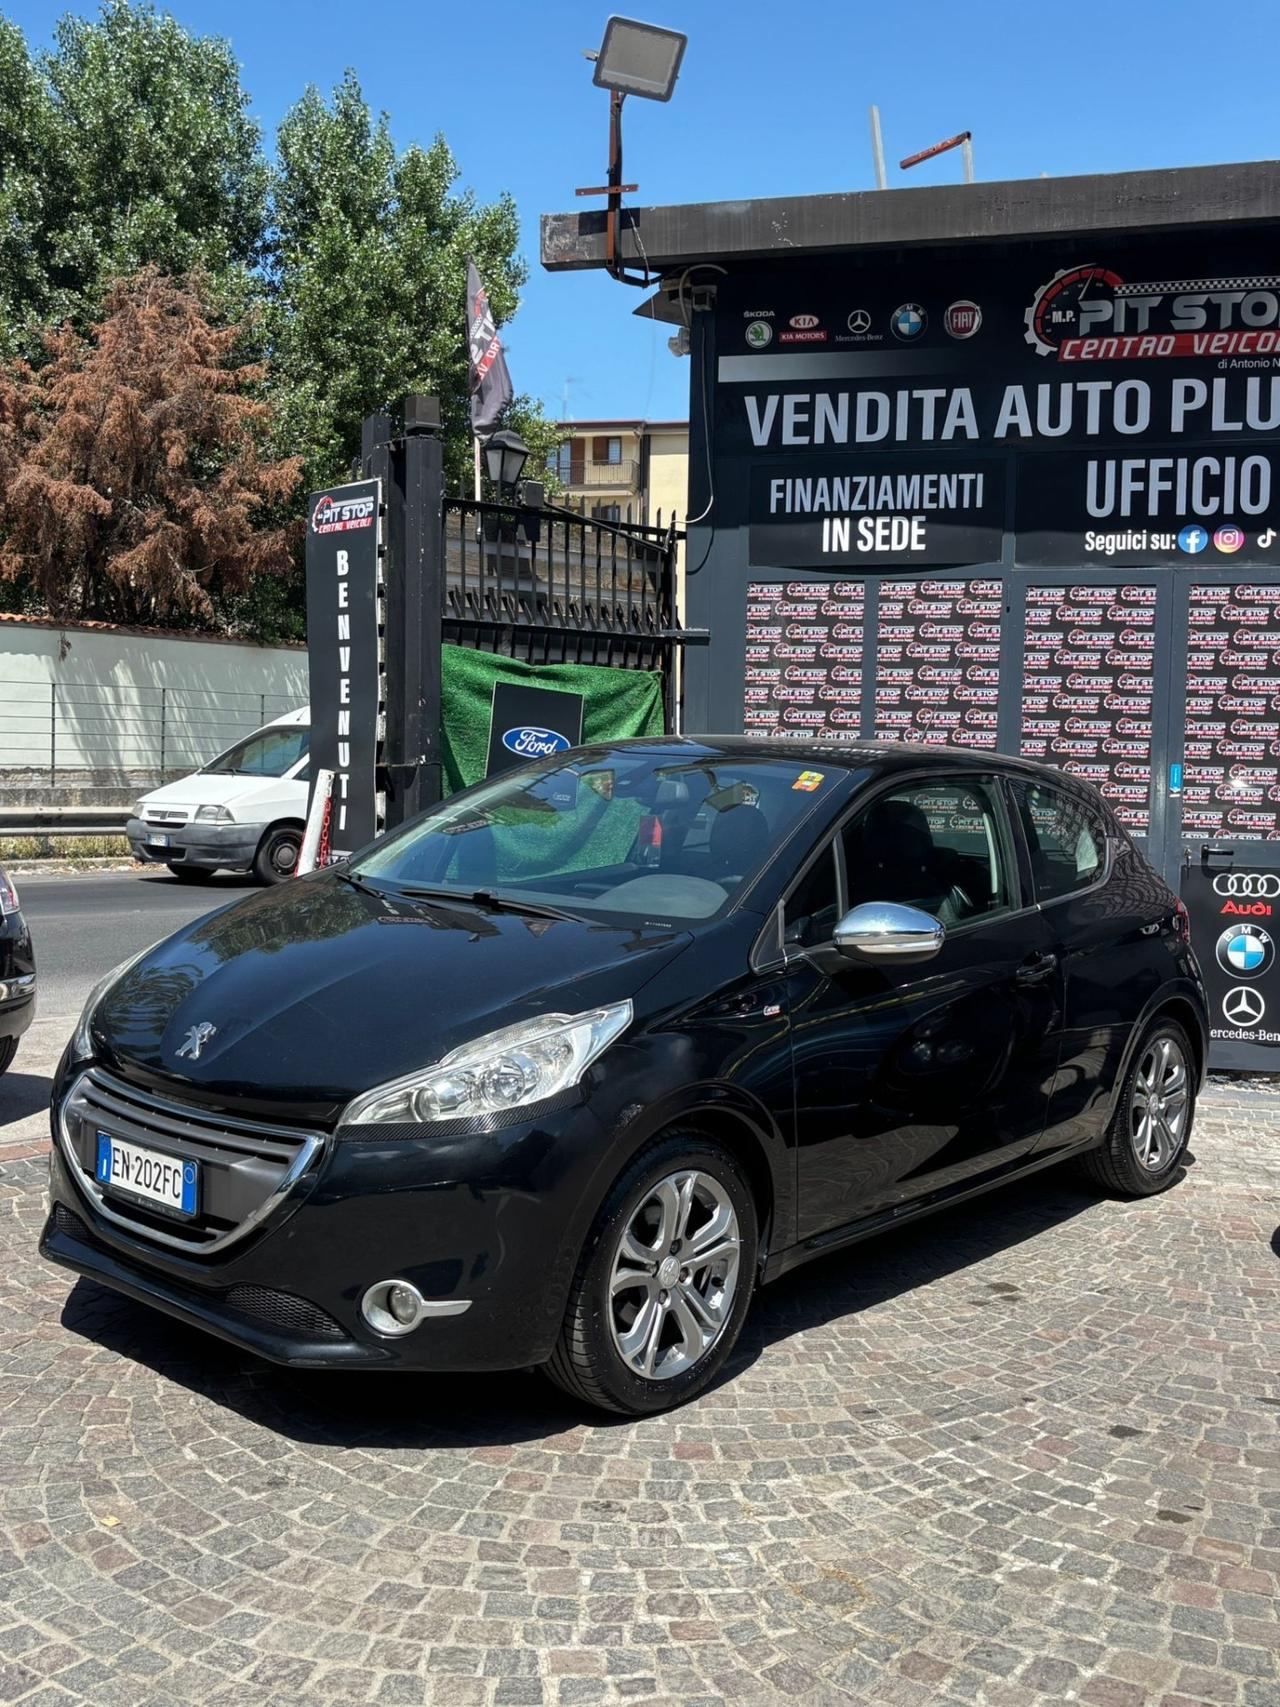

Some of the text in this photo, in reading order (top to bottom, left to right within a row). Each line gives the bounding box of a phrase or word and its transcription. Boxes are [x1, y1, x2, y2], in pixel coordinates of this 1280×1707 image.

[794, 317, 815, 326] KIA
[953, 311, 975, 329] FIAT
[1052, 310, 1076, 323] M.P.
[1079, 291, 1280, 336] PIT STO
[1218, 359, 1228, 369] di
[1230, 358, 1270, 368] Antonio
[744, 388, 980, 447] VENDITA
[993, 379, 1151, 438] AUTO
[770, 473, 984, 513] FINANZIAMENTI
[1086, 455, 1271, 518] UFFICIO
[322, 502, 374, 523] PIT STOP
[822, 515, 926, 552] IN SEDE
[1085, 529, 1176, 555] Seguici su:
[336, 550, 350, 830] BENVENUTI
[515, 730, 558, 754] Ford
[1220, 901, 1272, 916] Audi
[1223, 925, 1270, 944] BMW
